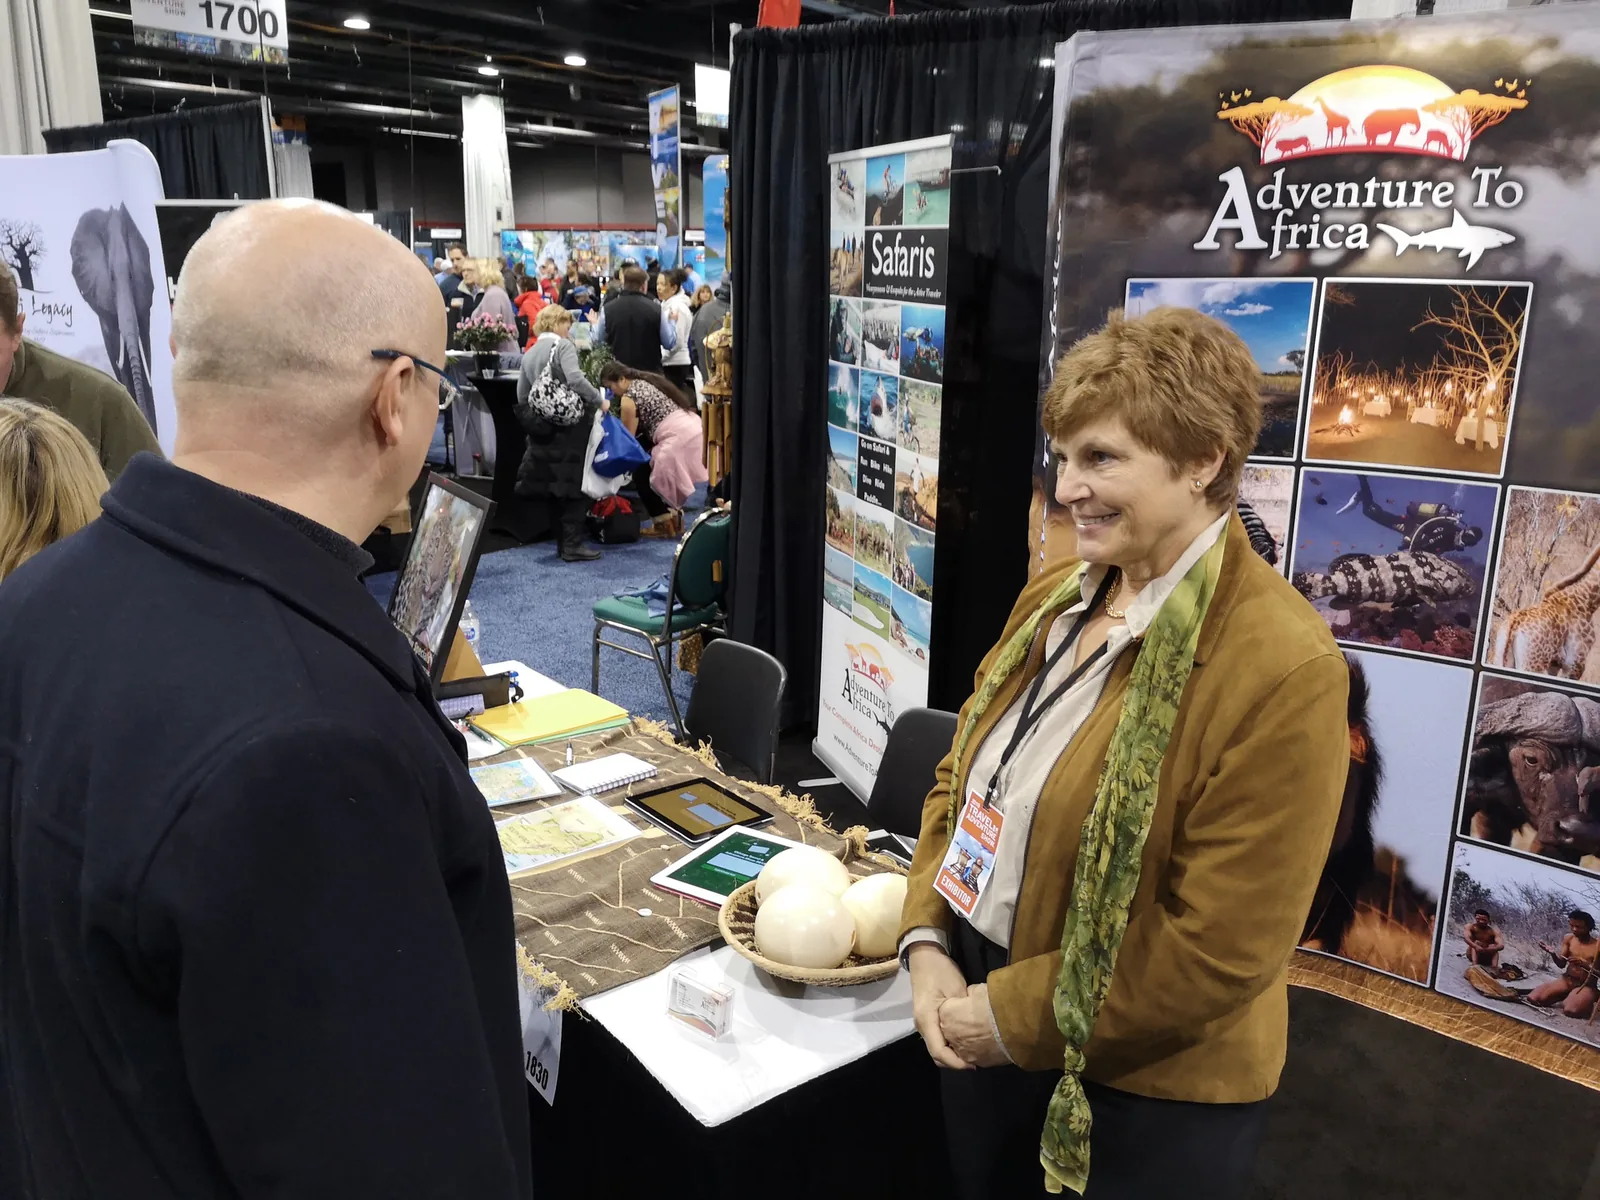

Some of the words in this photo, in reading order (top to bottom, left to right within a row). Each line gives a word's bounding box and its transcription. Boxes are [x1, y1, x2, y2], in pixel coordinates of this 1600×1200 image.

[199, 0, 279, 38] 1700
[1194, 166, 1455, 250] Adventure
[1471, 166, 1524, 208] To
[871, 231, 935, 279] Safaris
[32, 295, 73, 328] Legacy
[861, 439, 866, 448] Go
[873, 442, 885, 454] Safari
[860, 455, 868, 466] Run
[870, 459, 880, 471] Bike
[882, 462, 893, 475] Hike
[862, 473, 872, 486] Dive
[874, 478, 885, 490] Ride
[842, 668, 872, 719] Africa
[842, 668, 886, 714] Adventure
[886, 700, 895, 722] To
[852, 726, 868, 745] Africa
[965, 813, 997, 841] ADVENTURE
[969, 802, 996, 829] TRAVEL
[941, 874, 972, 907] EXHIBITOR
[526, 1050, 549, 1090] 1830
